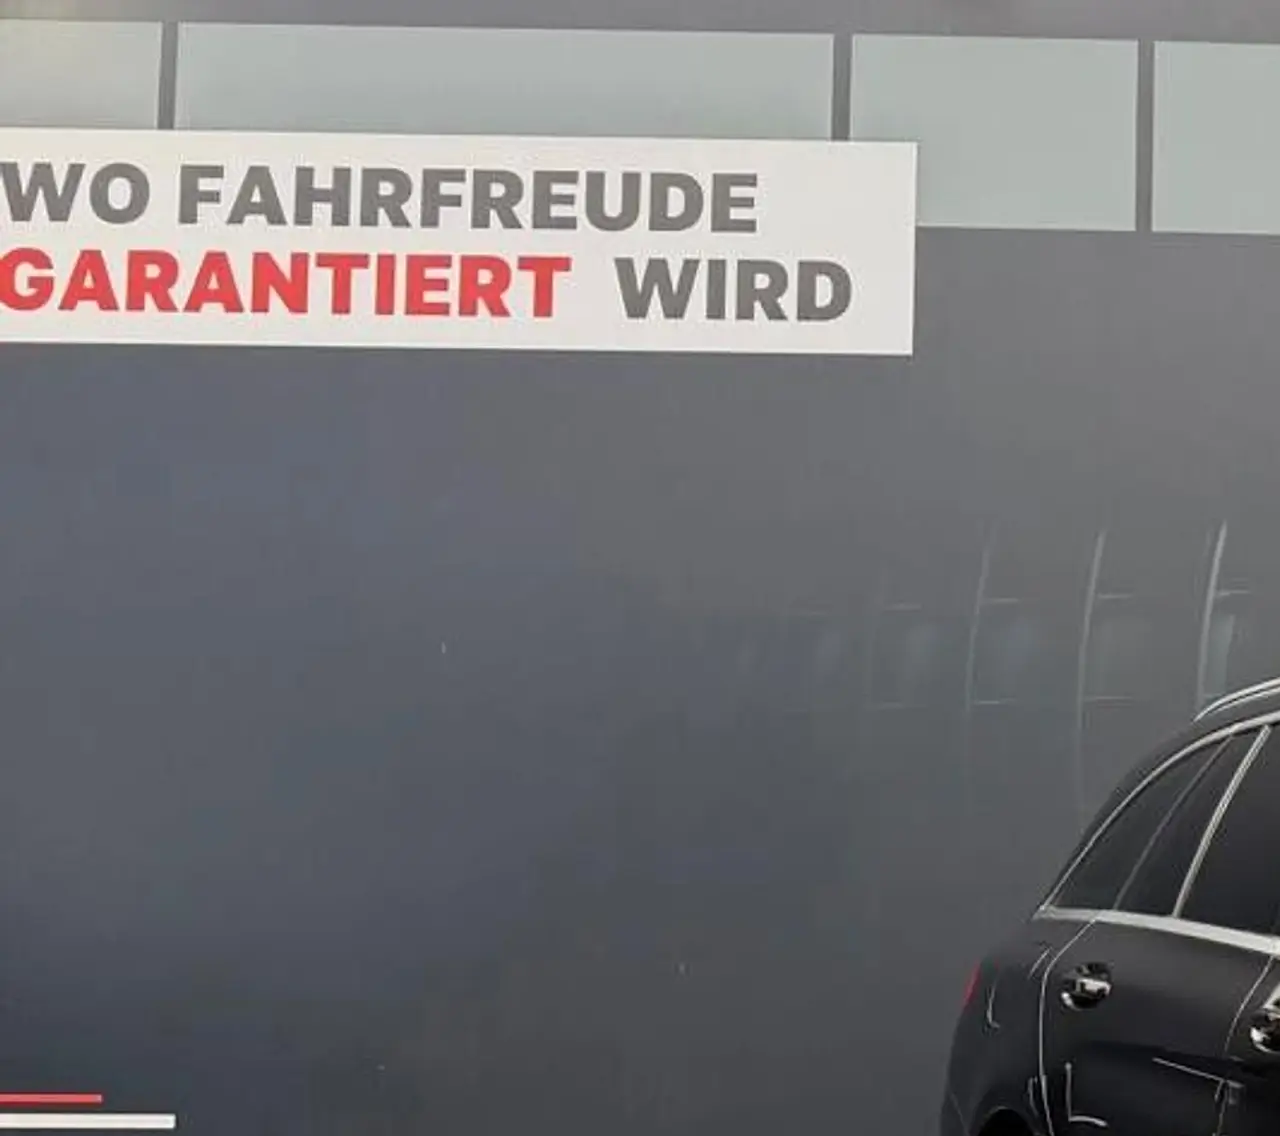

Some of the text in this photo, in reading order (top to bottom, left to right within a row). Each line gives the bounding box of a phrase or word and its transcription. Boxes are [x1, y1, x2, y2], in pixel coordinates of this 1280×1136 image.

[0, 161, 758, 235] WO FAHRFREUDE
[0, 247, 852, 322] GARANTIERT WIRD
